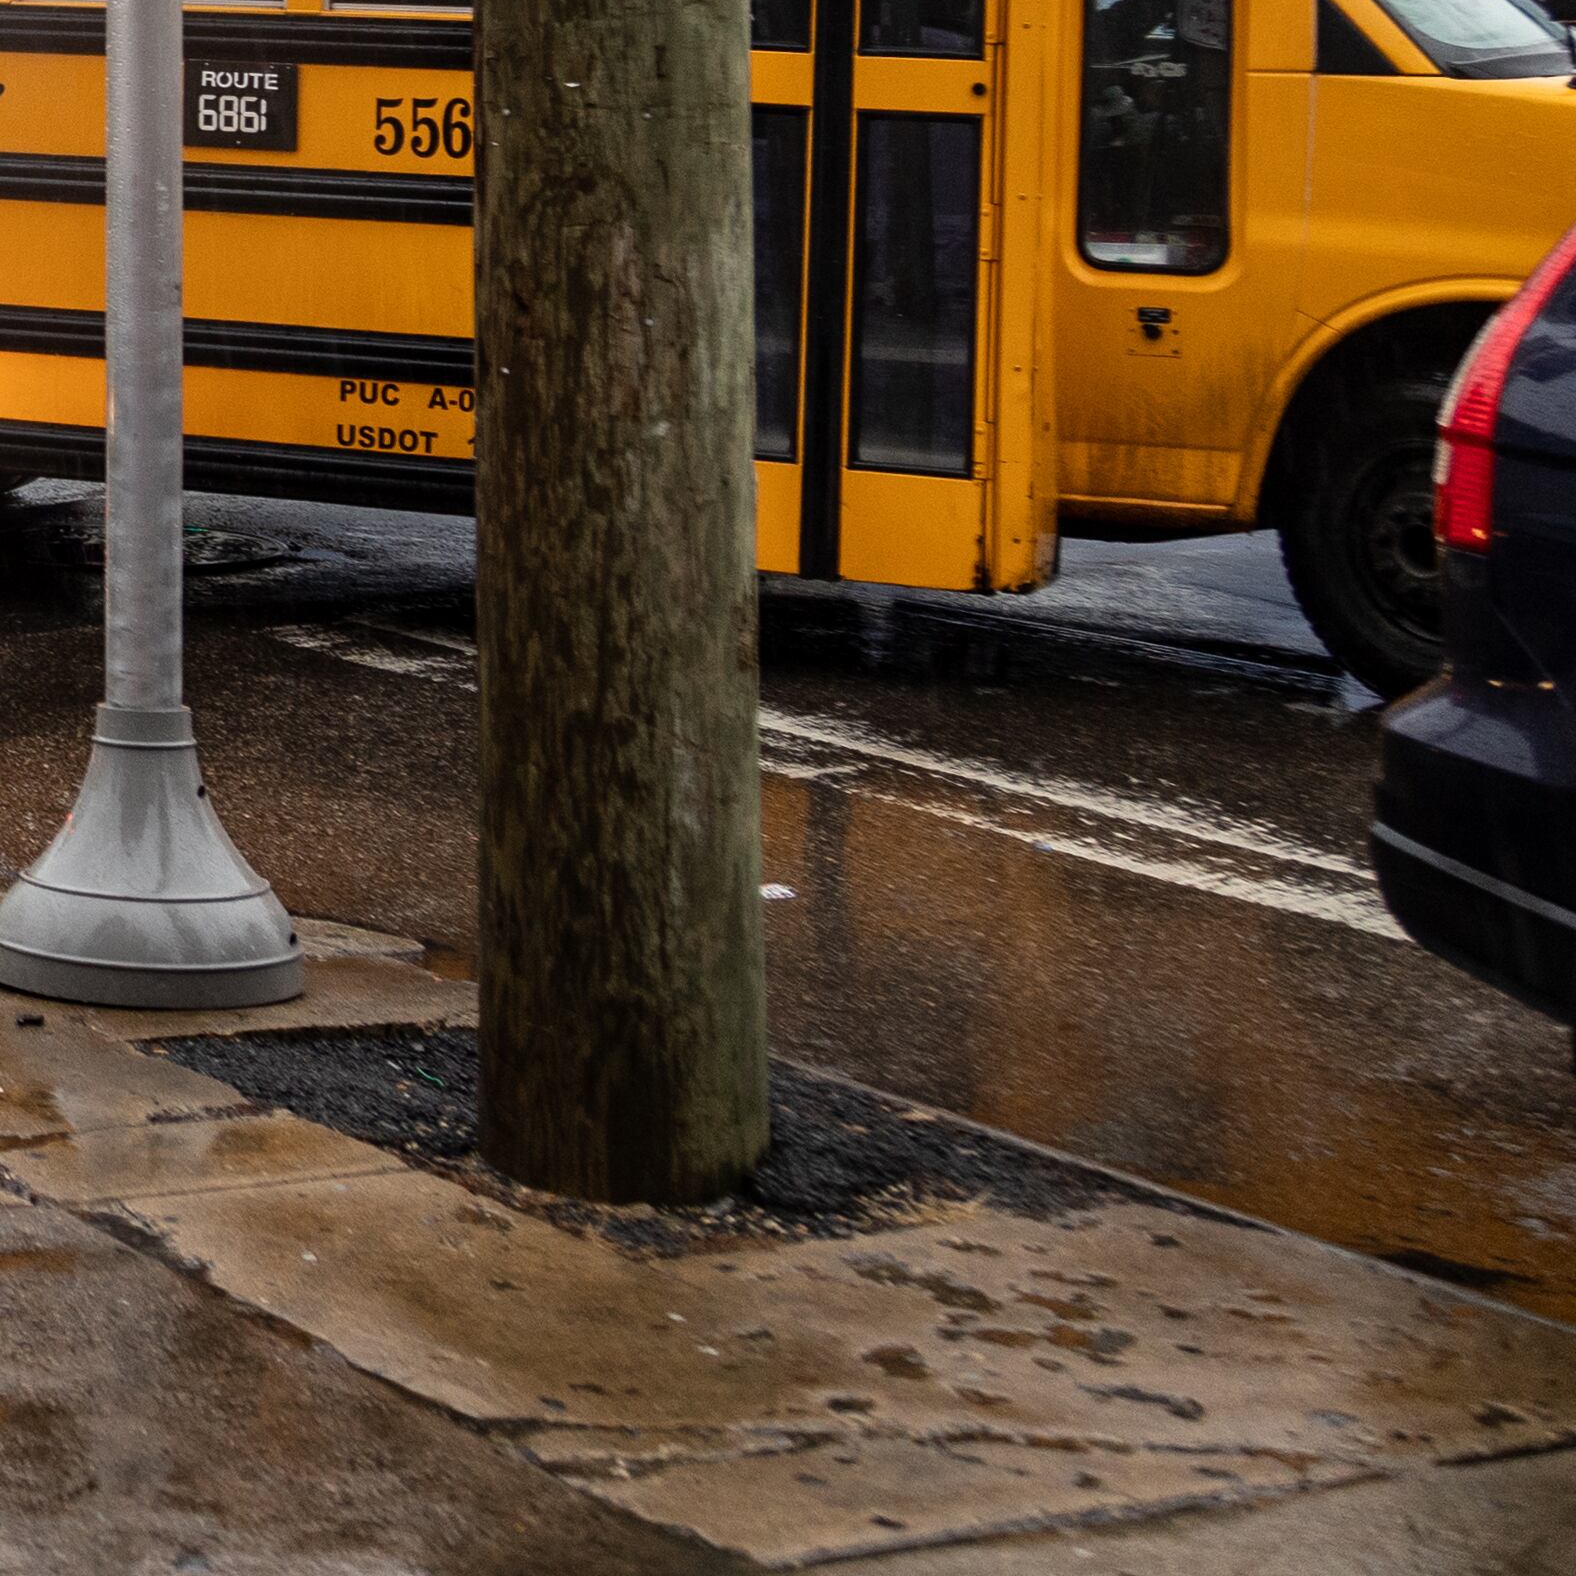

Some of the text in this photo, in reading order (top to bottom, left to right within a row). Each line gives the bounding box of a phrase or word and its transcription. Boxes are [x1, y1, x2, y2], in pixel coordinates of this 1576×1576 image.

[201, 70, 279, 90] ROUTE
[198, 94, 267, 133] 6861
[373, 97, 472, 159] 556
[339, 379, 475, 413] PUC A-0
[336, 423, 439, 454] USDOT
